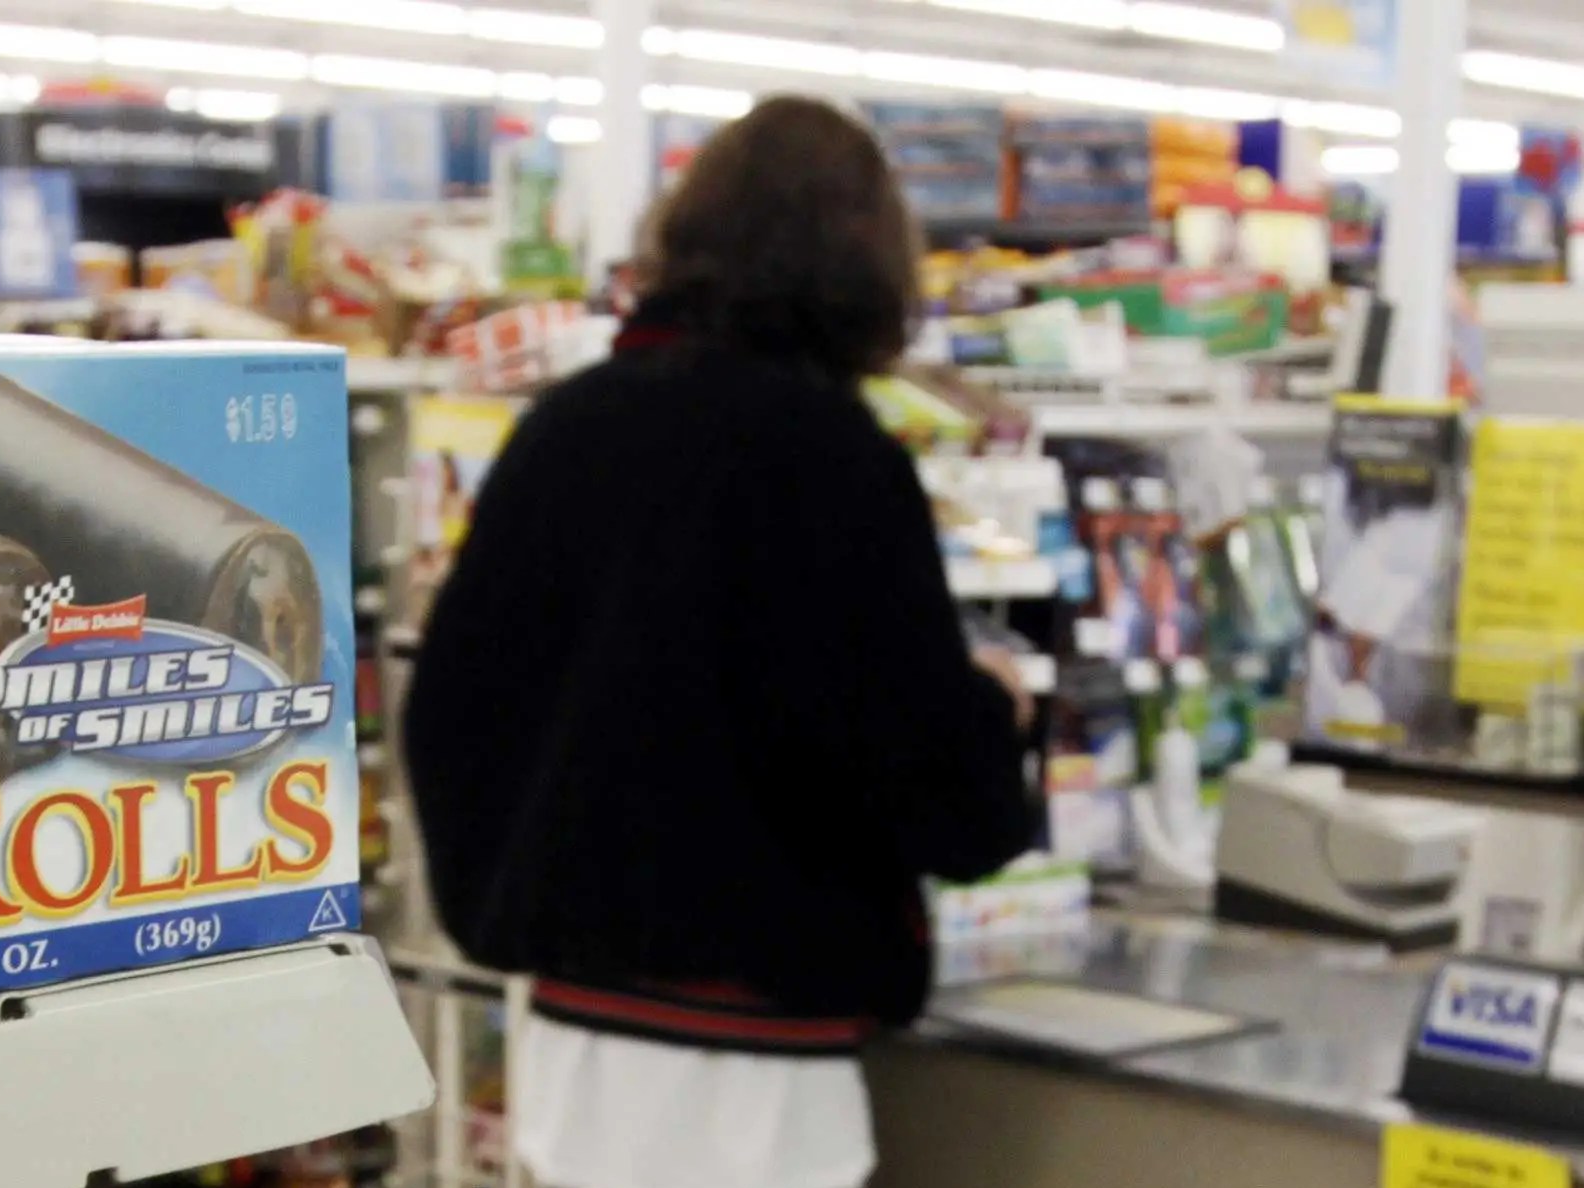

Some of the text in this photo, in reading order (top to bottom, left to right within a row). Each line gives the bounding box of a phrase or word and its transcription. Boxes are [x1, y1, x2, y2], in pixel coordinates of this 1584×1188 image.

[1, 645, 234, 712] MILES
[17, 683, 334, 751] OF SMILES
[1, 936, 59, 973] OZ.
[134, 913, 222, 957] (369g)
[1449, 982, 1538, 1028] VISA
